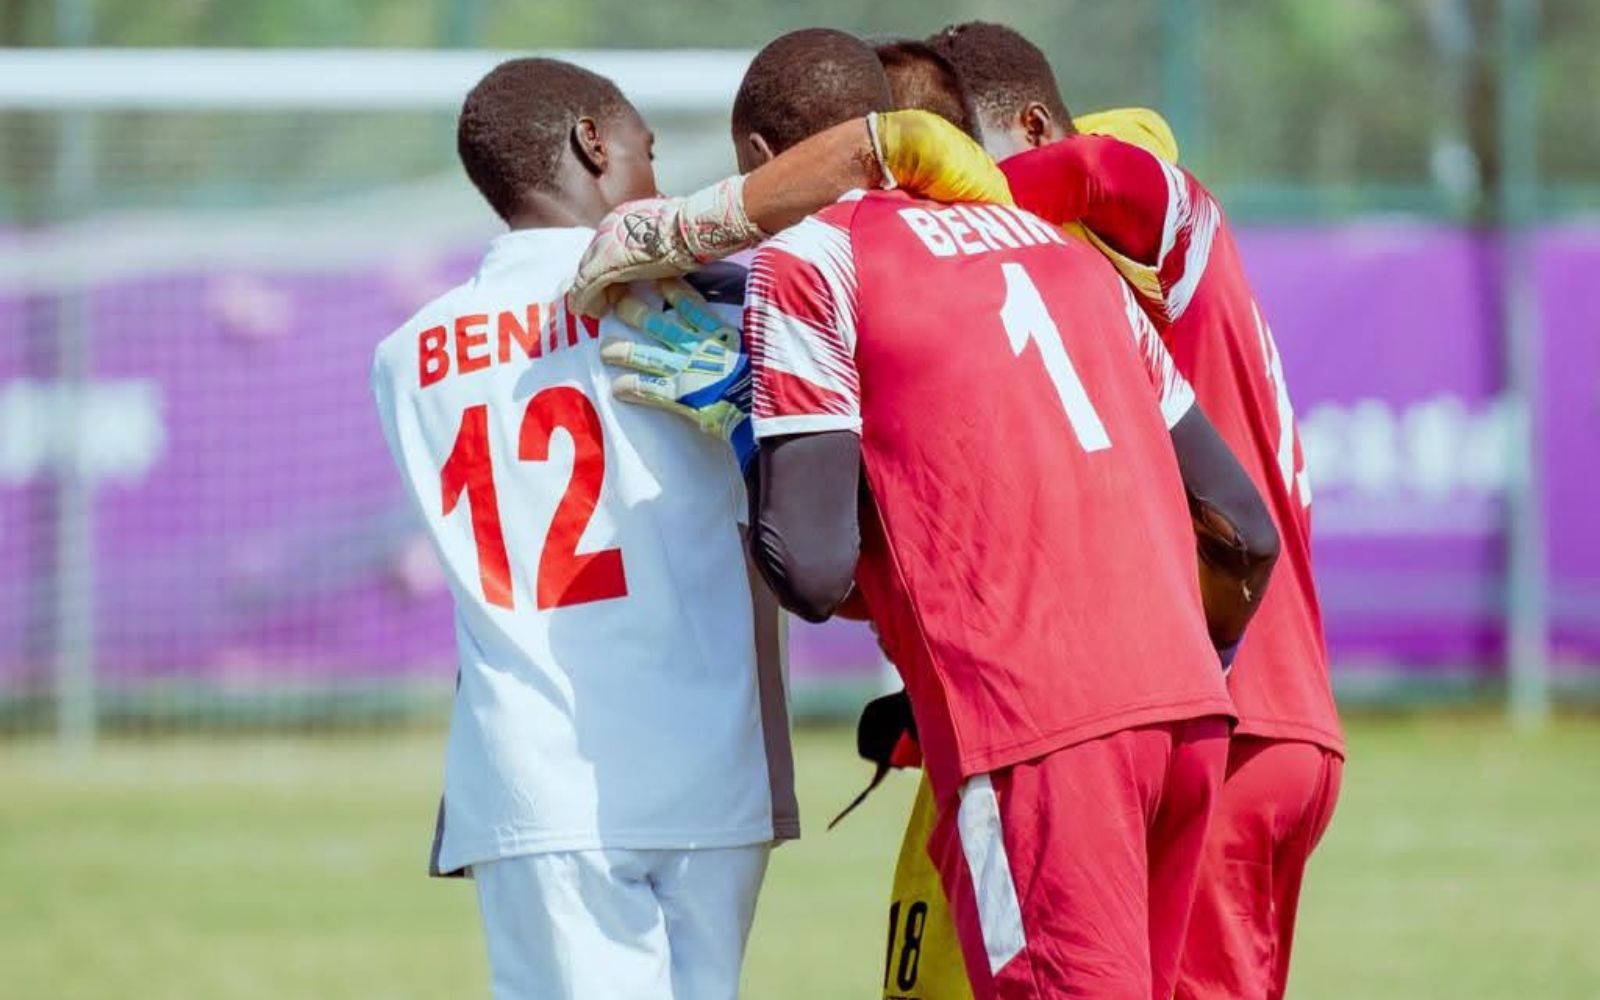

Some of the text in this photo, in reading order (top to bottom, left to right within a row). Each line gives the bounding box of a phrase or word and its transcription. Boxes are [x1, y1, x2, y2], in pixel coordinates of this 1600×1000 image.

[897, 204, 1067, 257] BENIN
[999, 262, 1113, 453] 1
[440, 386, 628, 612] 12
[884, 900, 928, 992] 18
